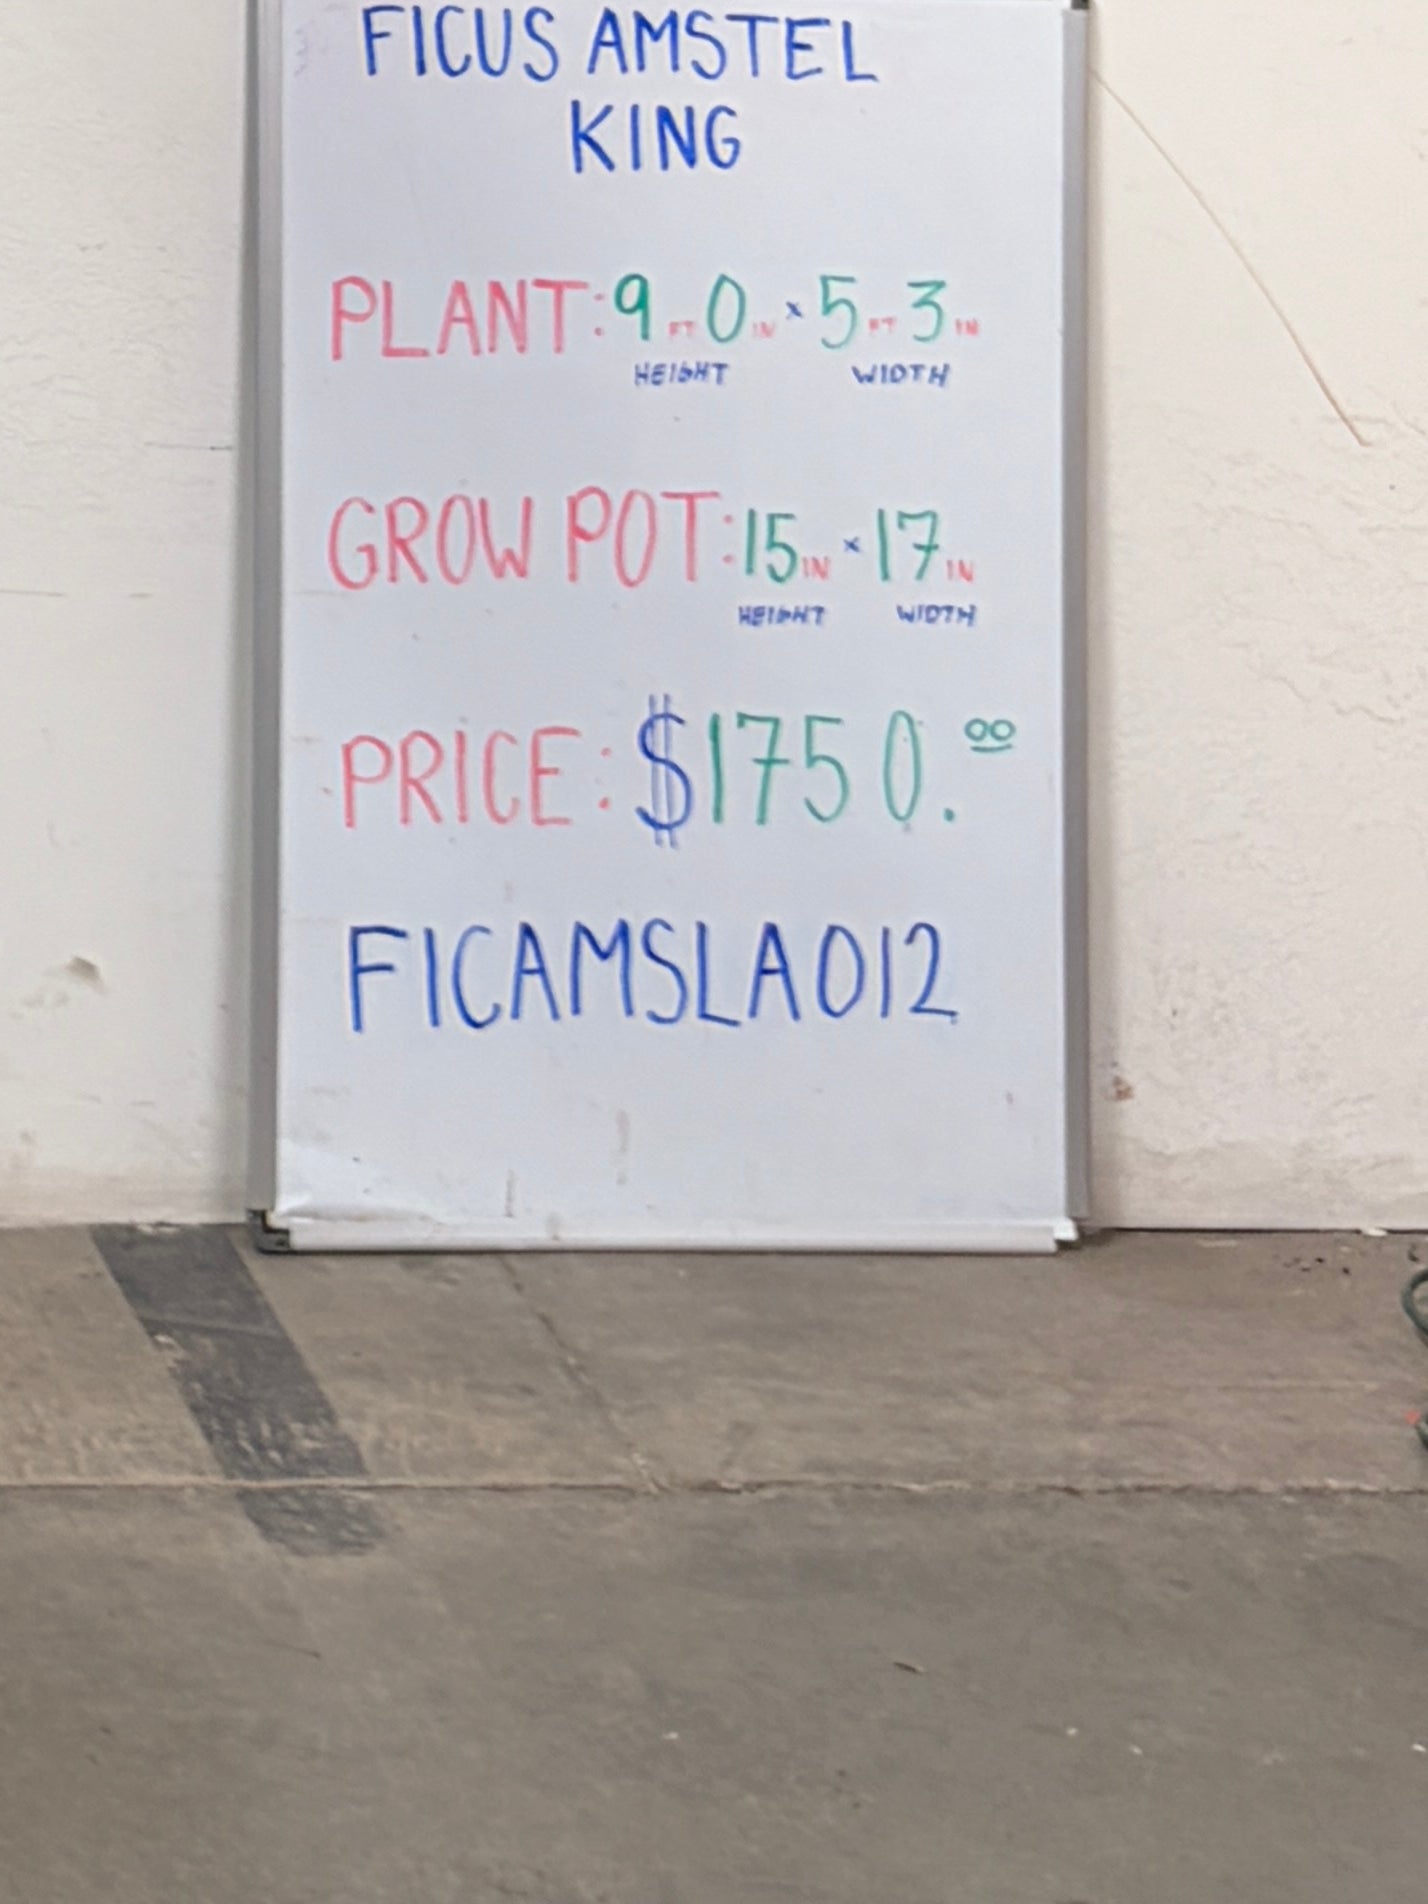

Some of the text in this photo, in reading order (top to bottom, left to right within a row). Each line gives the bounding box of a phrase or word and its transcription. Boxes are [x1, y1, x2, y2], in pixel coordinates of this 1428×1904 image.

[360, 3, 879, 83] FICUS AMSTEL
[570, 98, 742, 175] KING
[331, 275, 605, 362] PLANT:
[613, 272, 651, 342] 9
[706, 273, 747, 344] 0
[819, 274, 858, 350] 5
[906, 279, 947, 343] 3
[634, 361, 951, 388] HEIGHT WIDTH
[327, 494, 534, 591] GROW
[566, 485, 734, 589] POT:
[745, 508, 799, 585] 15
[877, 508, 940, 582] 17
[896, 603, 978, 628] WIDTH
[341, 725, 611, 829] PRICE:
[347, 917, 959, 1034] FICAMSLA012
